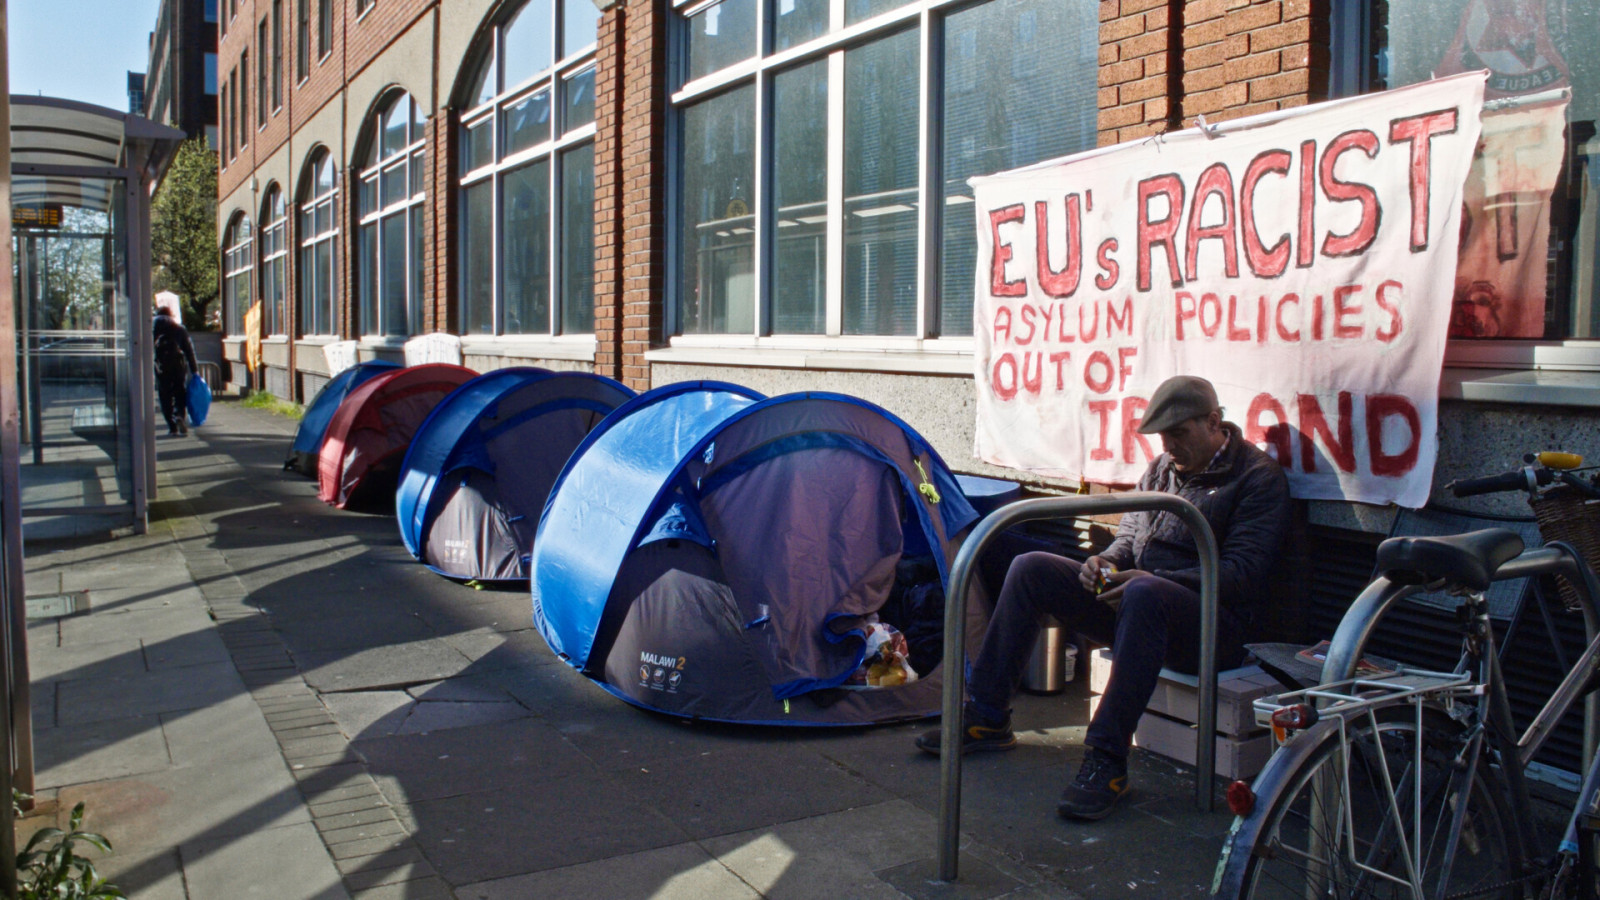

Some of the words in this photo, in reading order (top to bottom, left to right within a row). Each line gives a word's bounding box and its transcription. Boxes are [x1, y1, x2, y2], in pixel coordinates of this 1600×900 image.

[989, 190, 1120, 297] EU's
[1137, 107, 1459, 292] RACIST
[994, 296, 1133, 345] ASYLUM
[1175, 279, 1404, 343] POLICIES
[992, 352, 1070, 400] OUT
[1083, 347, 1138, 394] OF
[1088, 391, 1422, 477] IRAND
[640, 651, 676, 668] MALAWI
[676, 657, 686, 670] 2
